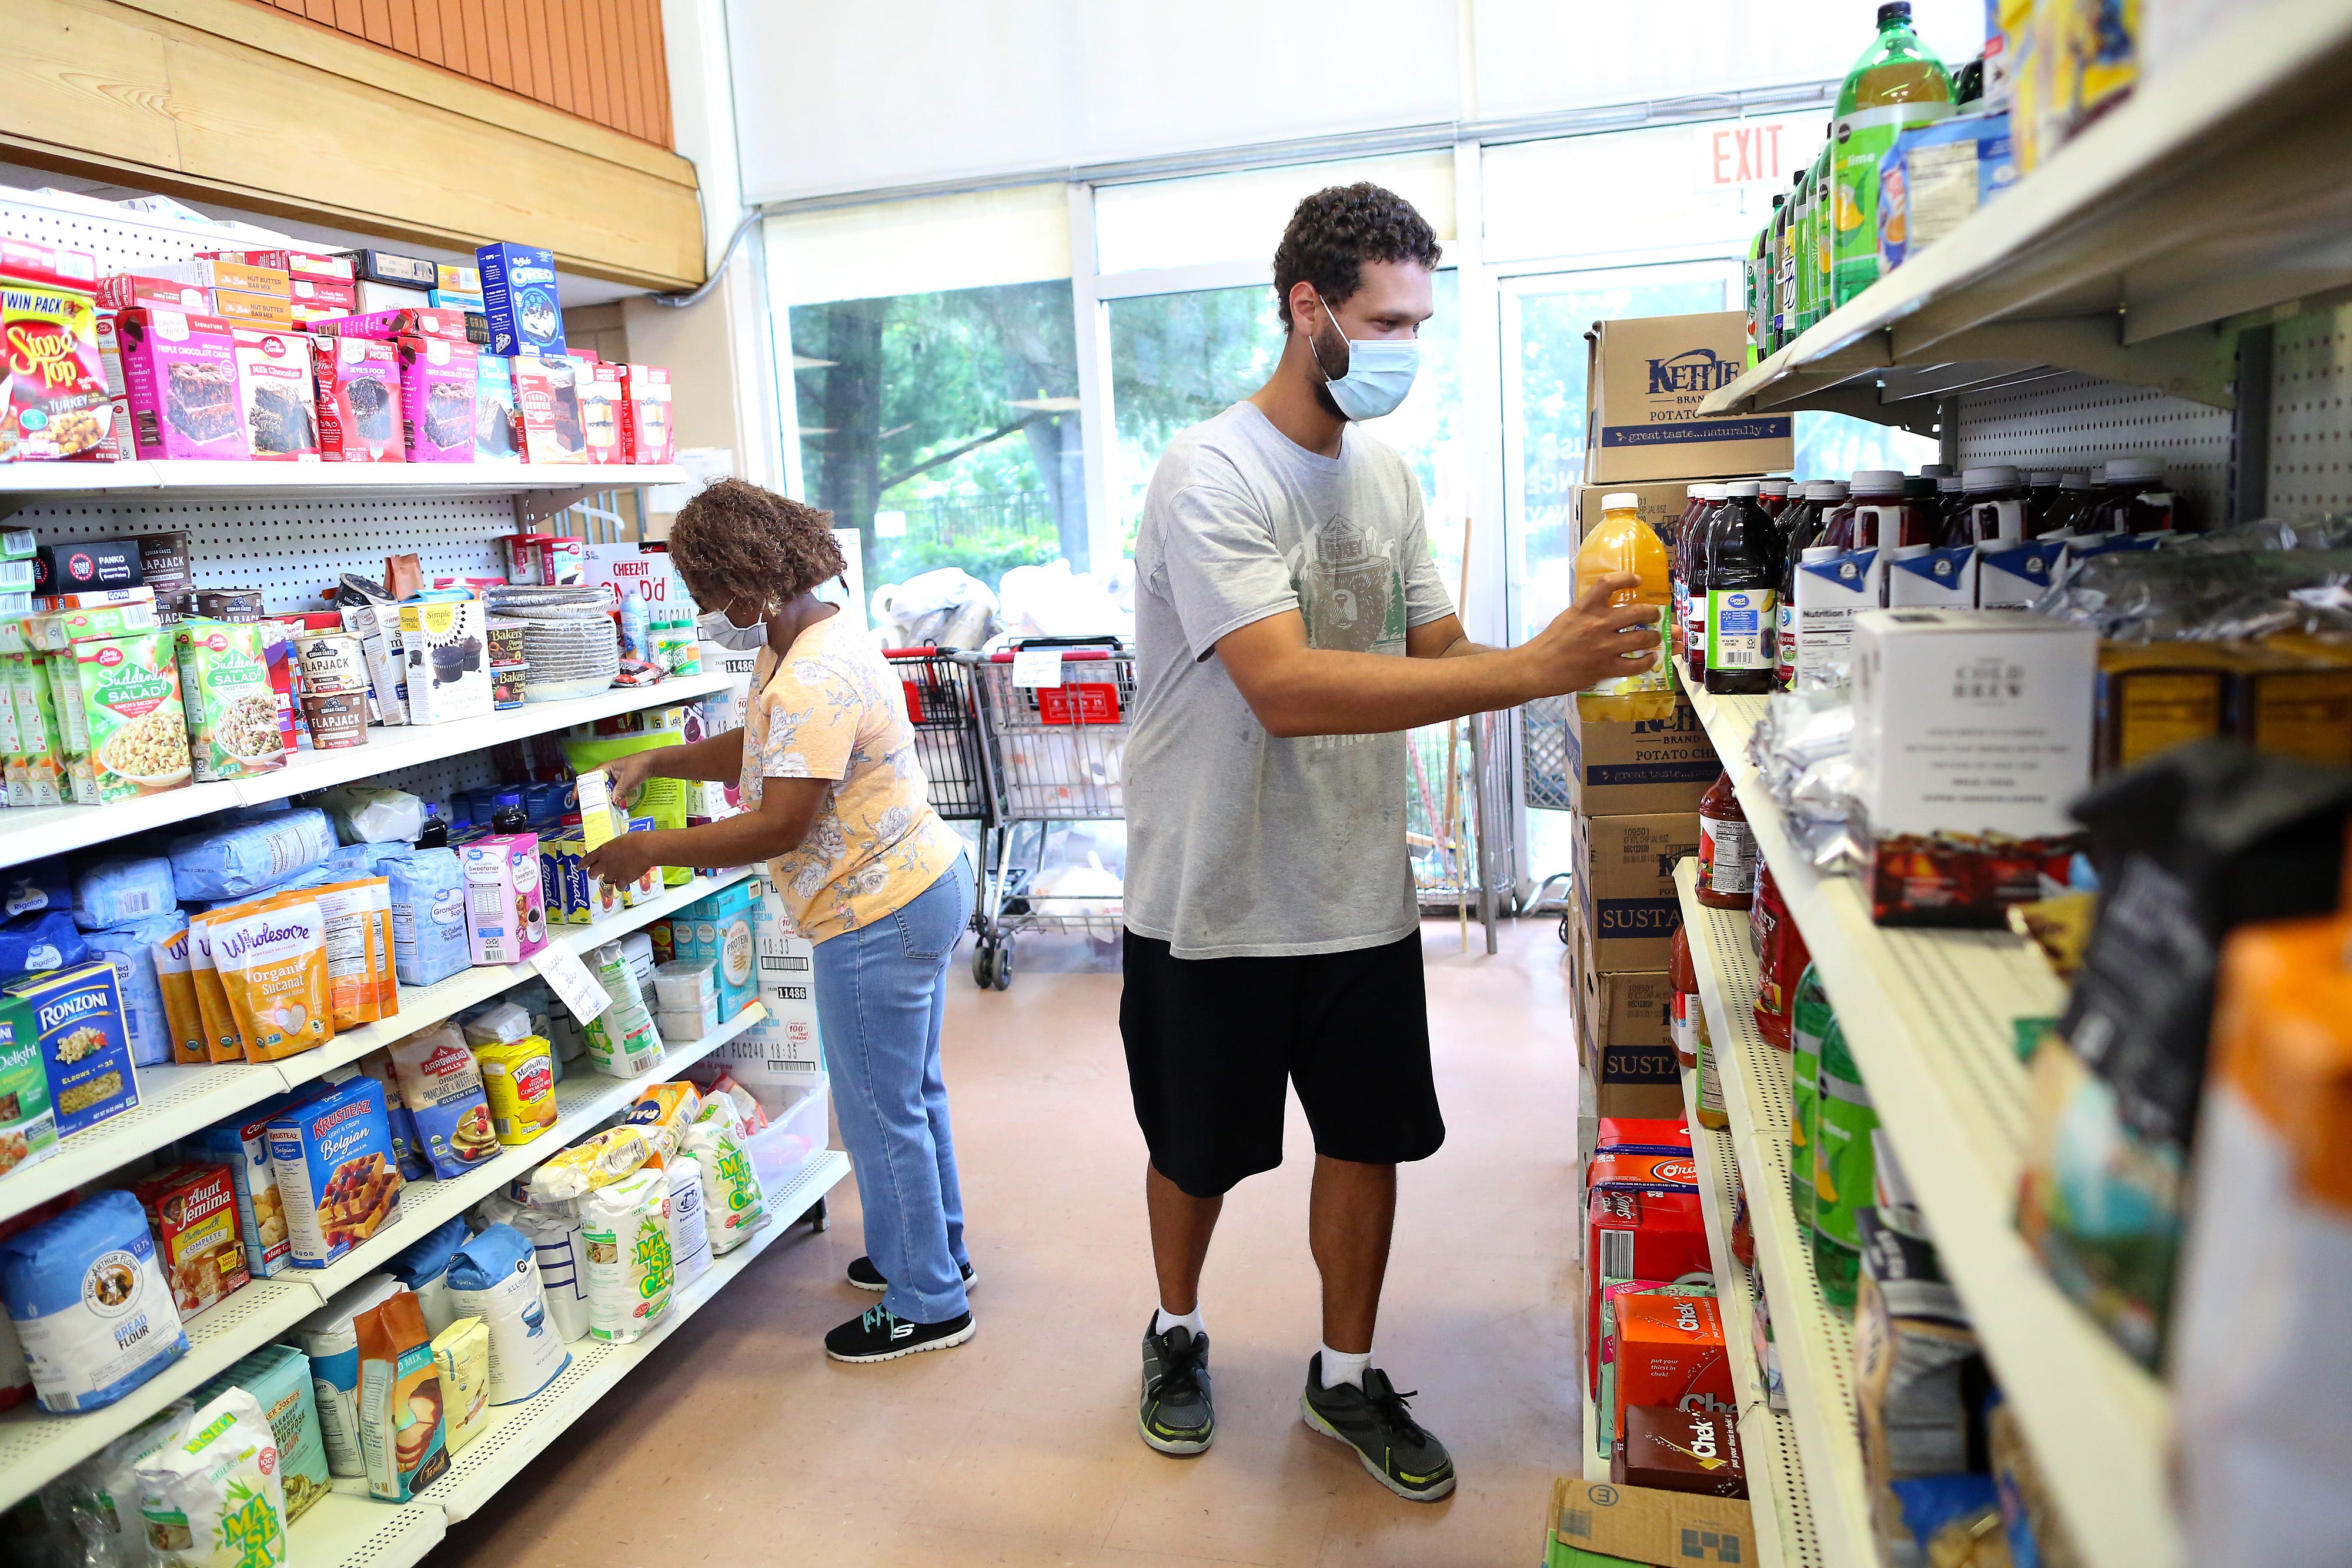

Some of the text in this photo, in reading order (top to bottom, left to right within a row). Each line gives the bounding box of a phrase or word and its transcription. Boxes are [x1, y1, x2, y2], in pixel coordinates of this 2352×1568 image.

[1713, 124, 1783, 183] EXIT
[260, 277, 281, 285] BUTTER
[511, 267, 554, 286] OREO
[34, 296, 62, 314] PACK
[263, 305, 283, 313] BUTTER
[194, 321, 223, 330] SIGNATURE
[7, 327, 78, 375] Stove
[156, 345, 231, 359] TRIPLE CHOCOLATE CHUNK
[369, 351, 393, 360] MOIST
[42, 360, 77, 389] Top
[269, 368, 300, 378] Chocolate
[49, 394, 88, 412] TURKEY
[1629, 432, 1661, 443] great
[98, 555, 125, 565] PANKO
[108, 590, 129, 599] GOYA
[427, 610, 450, 618] Simple
[100, 655, 121, 663] Crocker
[209, 650, 261, 677] Suddenly
[302, 658, 349, 673] FLAPJACK
[98, 663, 167, 691] Suddenly
[215, 673, 258, 685] SALAD
[108, 688, 162, 703] SALAD
[311, 713, 360, 728] FLAPJACK
[1664, 736, 1700, 744] BRAND
[515, 870, 535, 881] Sweetener
[541, 858, 559, 906] equal
[14, 898, 43, 910] Rigatoni
[222, 922, 310, 958] Wholesome
[727, 934, 749, 951] PROTEIN
[763, 938, 790, 955] 18:33
[32, 955, 57, 968] Rigatoni
[253, 961, 307, 983] Organic
[262, 975, 305, 995] Sucanat
[779, 987, 806, 999] 11486
[39, 992, 108, 1031] RONZONI
[731, 1043, 797, 1059] FLC240 18:35
[424, 1050, 467, 1073] ARROWHEAD
[440, 1062, 462, 1074] MILLS
[62, 1070, 90, 1084] ELBOWS
[439, 1070, 470, 1085] ORGANIC
[423, 1085, 450, 1102] PANCAKE
[455, 1076, 476, 1089] WAFFLE
[442, 1088, 478, 1104] GLUTEN FREE
[313, 1099, 370, 1141] KRUSTEAZ
[329, 1128, 341, 1139] LIGHT
[346, 1119, 359, 1129] CRISPY
[274, 1146, 296, 1155] Belgian
[320, 1126, 370, 1161] Belgian
[189, 1179, 221, 1207] Aunt
[178, 1190, 232, 1232] Jemima
[1602, 1197, 1612, 1213] COLA
[1611, 1192, 1636, 1220] Sam's
[183, 1216, 220, 1243] Buttermilk
[133, 1239, 150, 1254] 12.7%
[185, 1231, 222, 1254] COMPLETE
[267, 1248, 281, 1262] Many
[222, 1259, 235, 1268] GREAT
[86, 1254, 138, 1299] KING ARTHUR FLOUR
[1673, 1302, 1700, 1331] Chek
[114, 1315, 147, 1342] BREAD
[118, 1325, 150, 1350] FLOUR
[405, 1354, 422, 1366] MIX
[1689, 1420, 1717, 1458] Chek
[260, 1457, 272, 1466] 100
